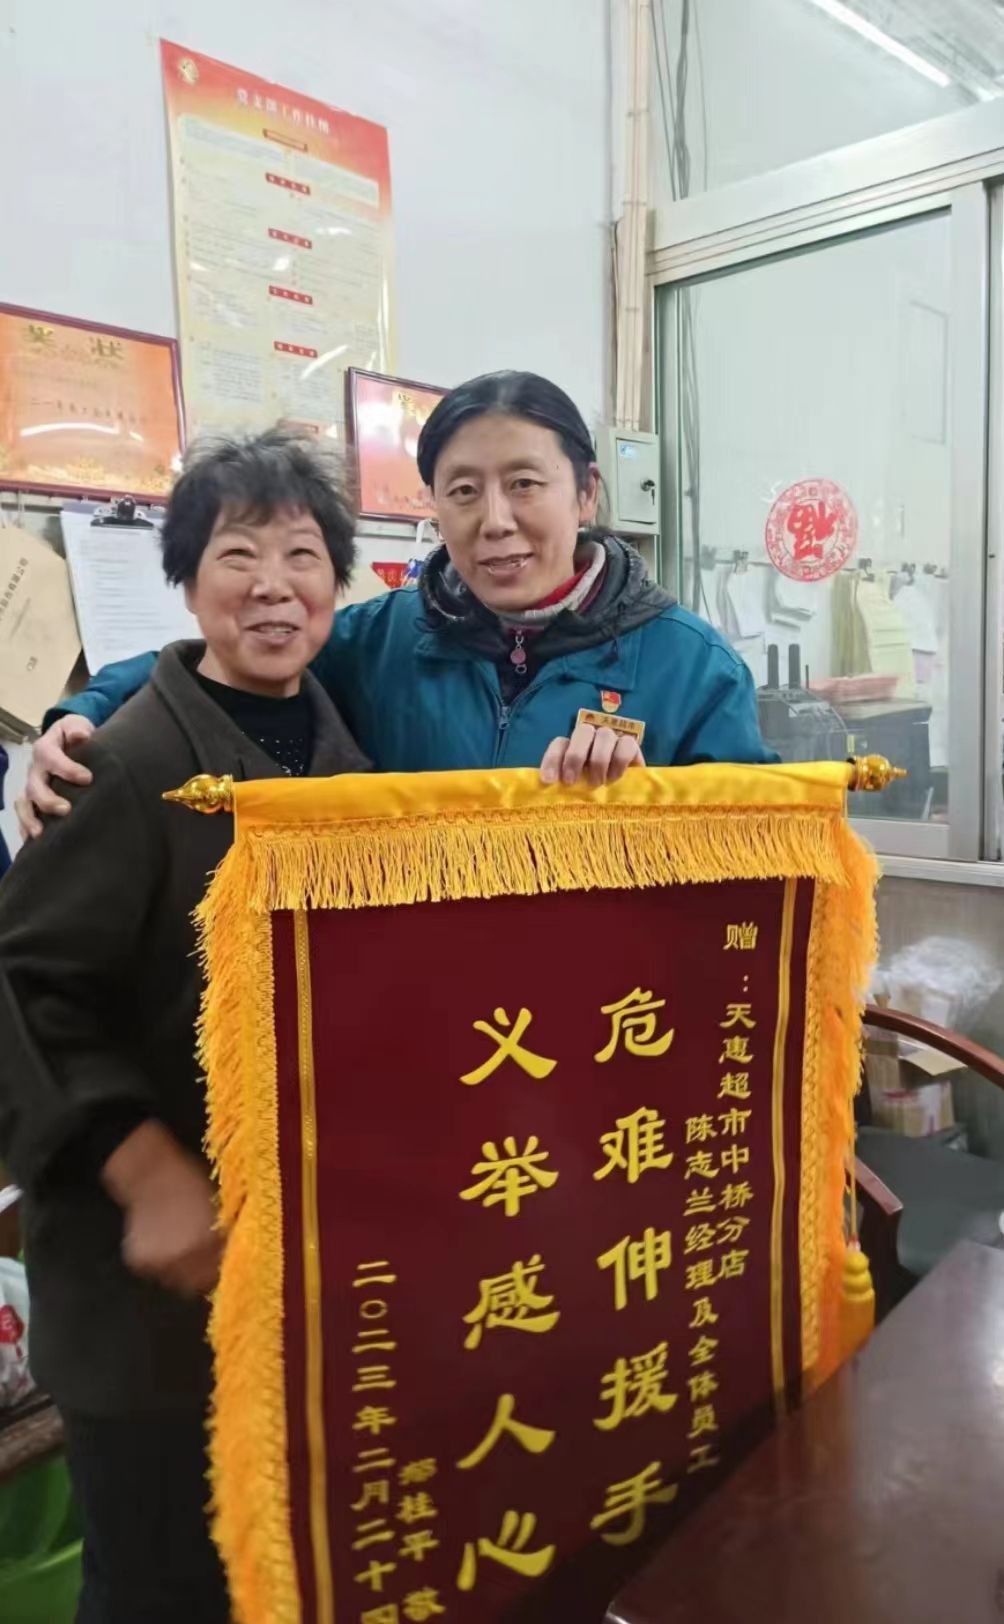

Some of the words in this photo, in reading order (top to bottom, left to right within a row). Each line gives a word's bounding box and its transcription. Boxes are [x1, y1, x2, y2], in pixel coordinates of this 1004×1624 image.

[457, 1006, 560, 1592] 义举感人心
[591, 986, 677, 1546] 危难伸援手
[683, 1112, 719, 1475] 陈志兰经理及全体员工
